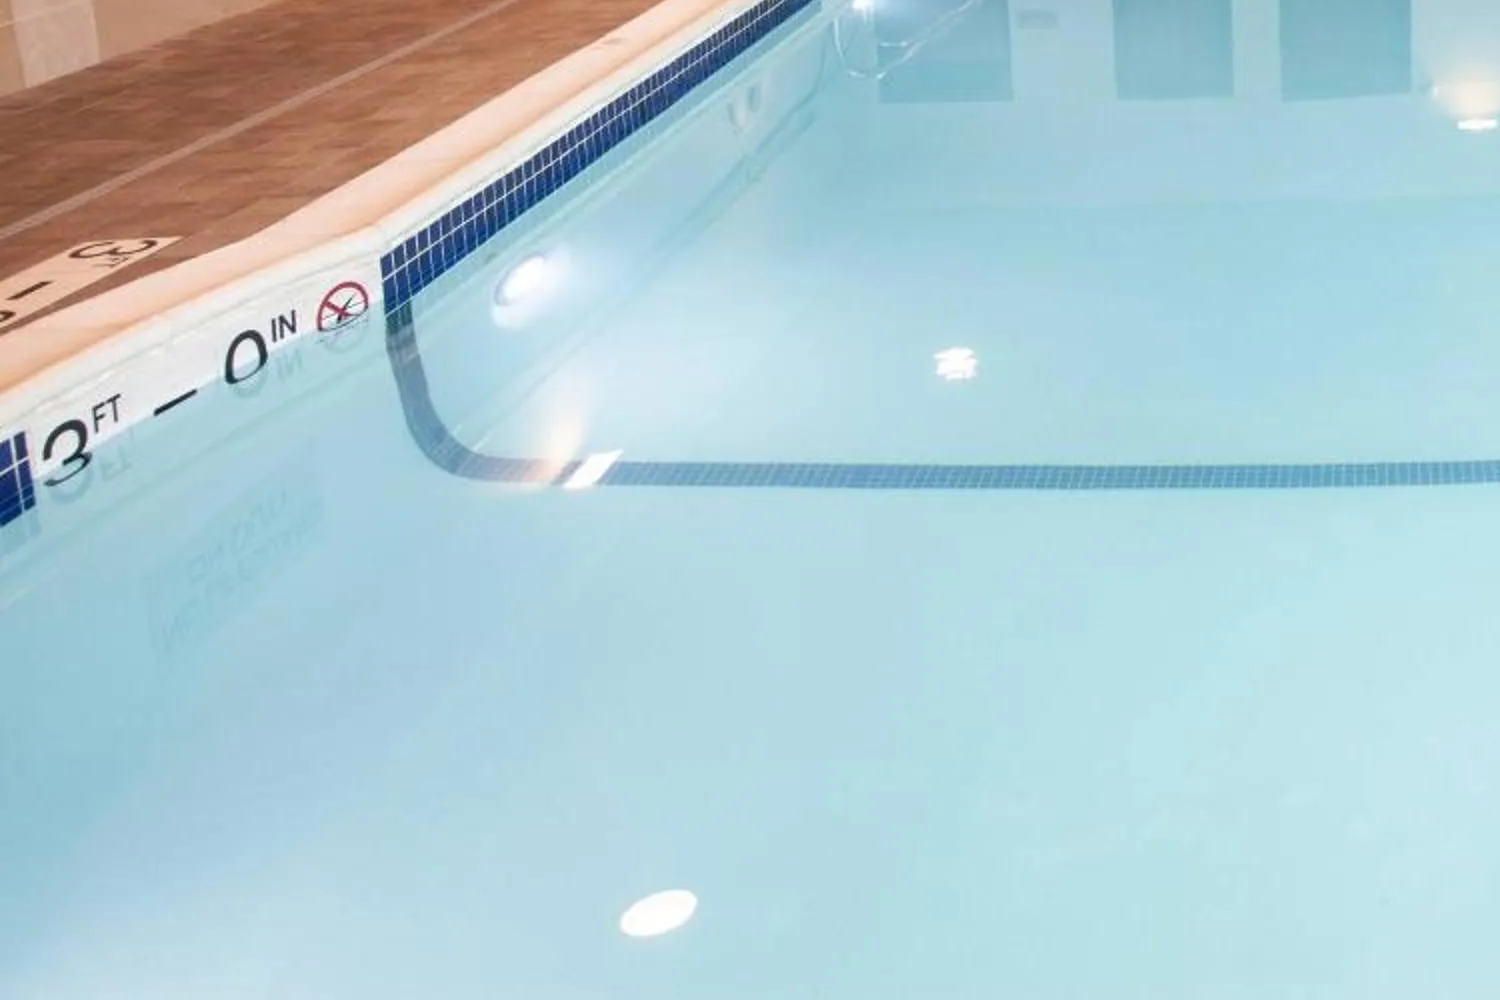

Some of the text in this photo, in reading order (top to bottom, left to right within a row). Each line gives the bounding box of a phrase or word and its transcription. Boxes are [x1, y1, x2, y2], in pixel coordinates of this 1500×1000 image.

[42, 419, 92, 487] 3
[92, 393, 122, 433] FT
[224, 328, 269, 385] 0
[271, 309, 298, 343] IN
